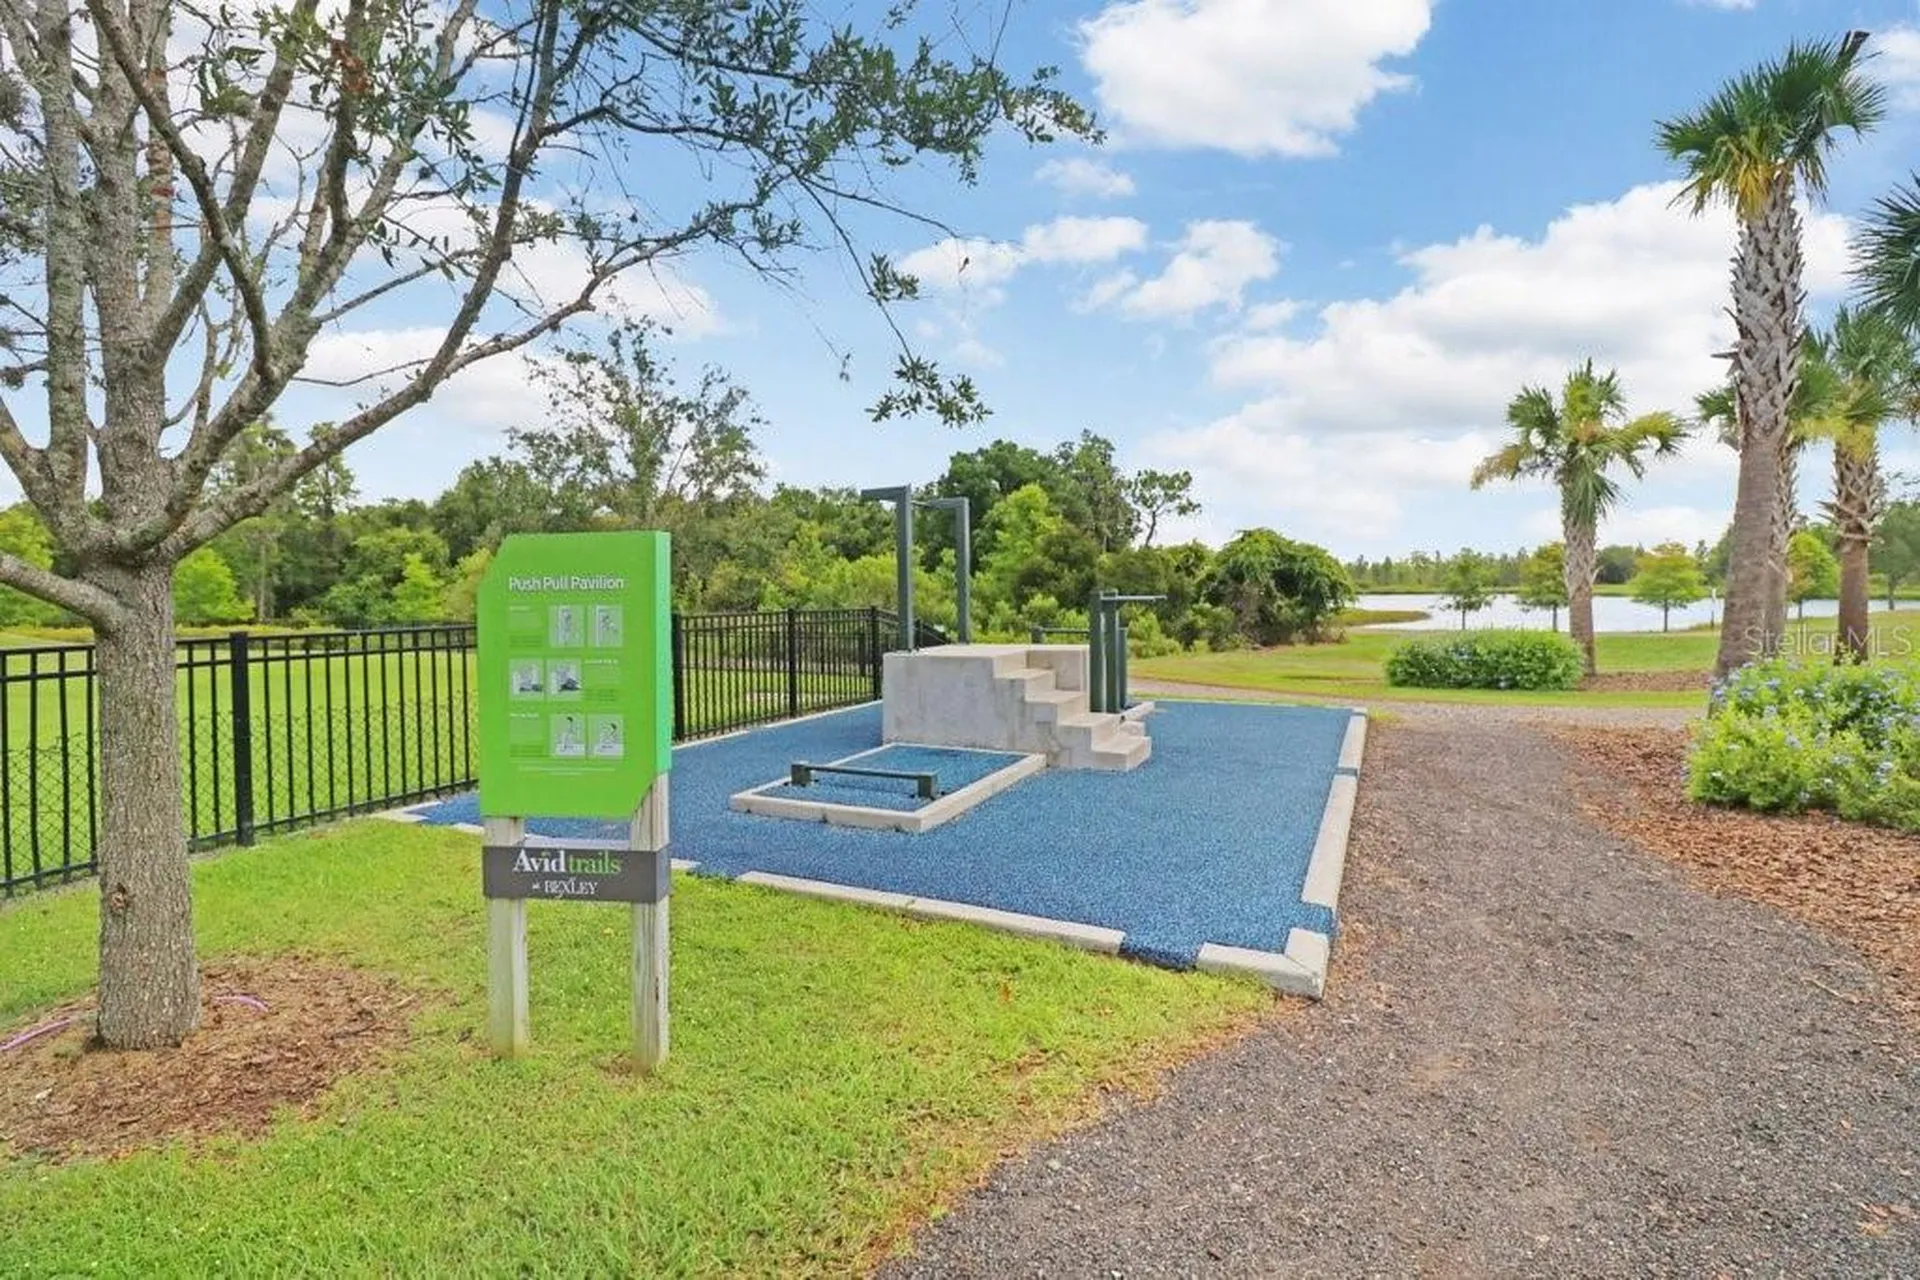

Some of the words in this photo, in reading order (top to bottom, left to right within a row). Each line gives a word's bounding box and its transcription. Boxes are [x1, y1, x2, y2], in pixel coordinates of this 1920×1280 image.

[509, 577, 541, 592] Push
[543, 576, 568, 591] Pull
[571, 575, 625, 591] Pavilion
